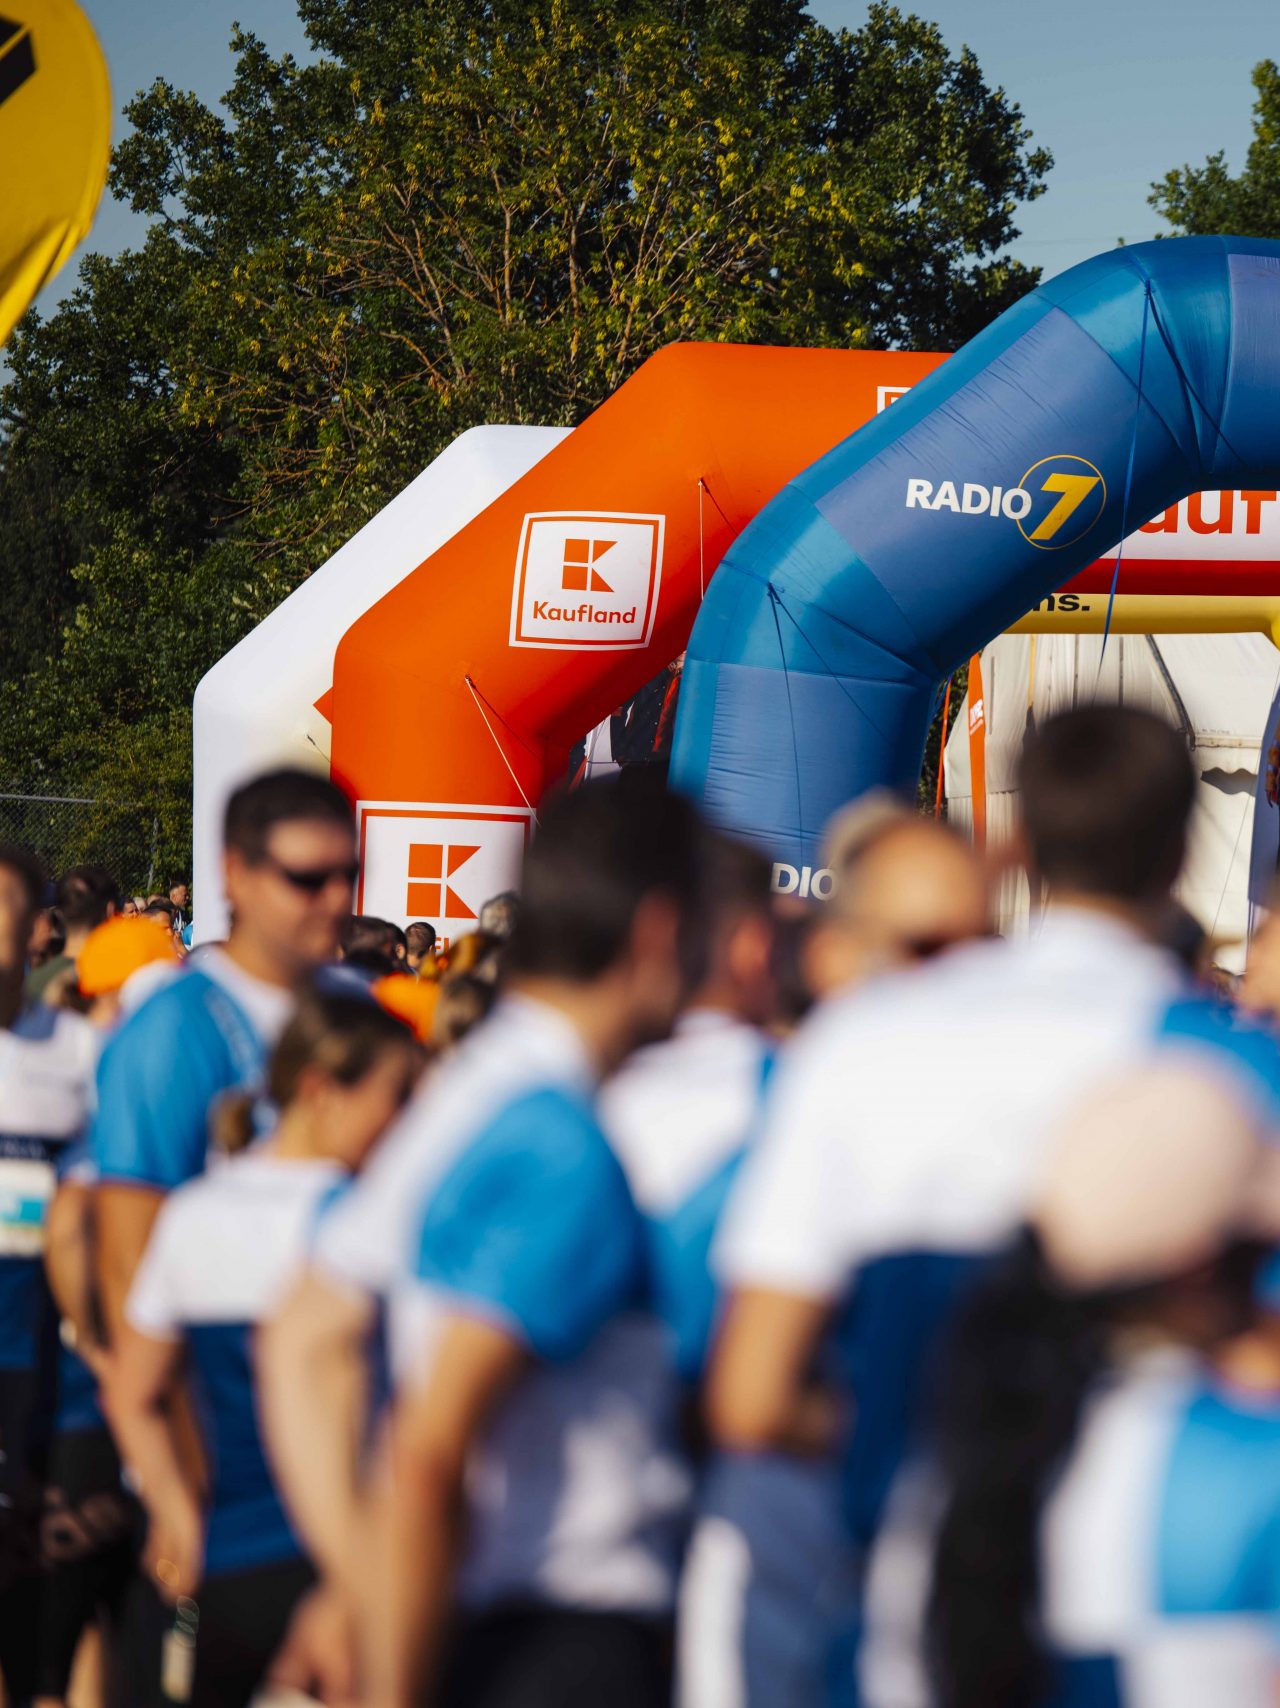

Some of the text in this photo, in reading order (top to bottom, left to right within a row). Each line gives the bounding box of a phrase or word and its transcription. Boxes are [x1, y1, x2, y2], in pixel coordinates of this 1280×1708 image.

[905, 472, 1102, 541] RADIO 7
[532, 600, 636, 625] Kaufland
[770, 862, 841, 902] DIO
